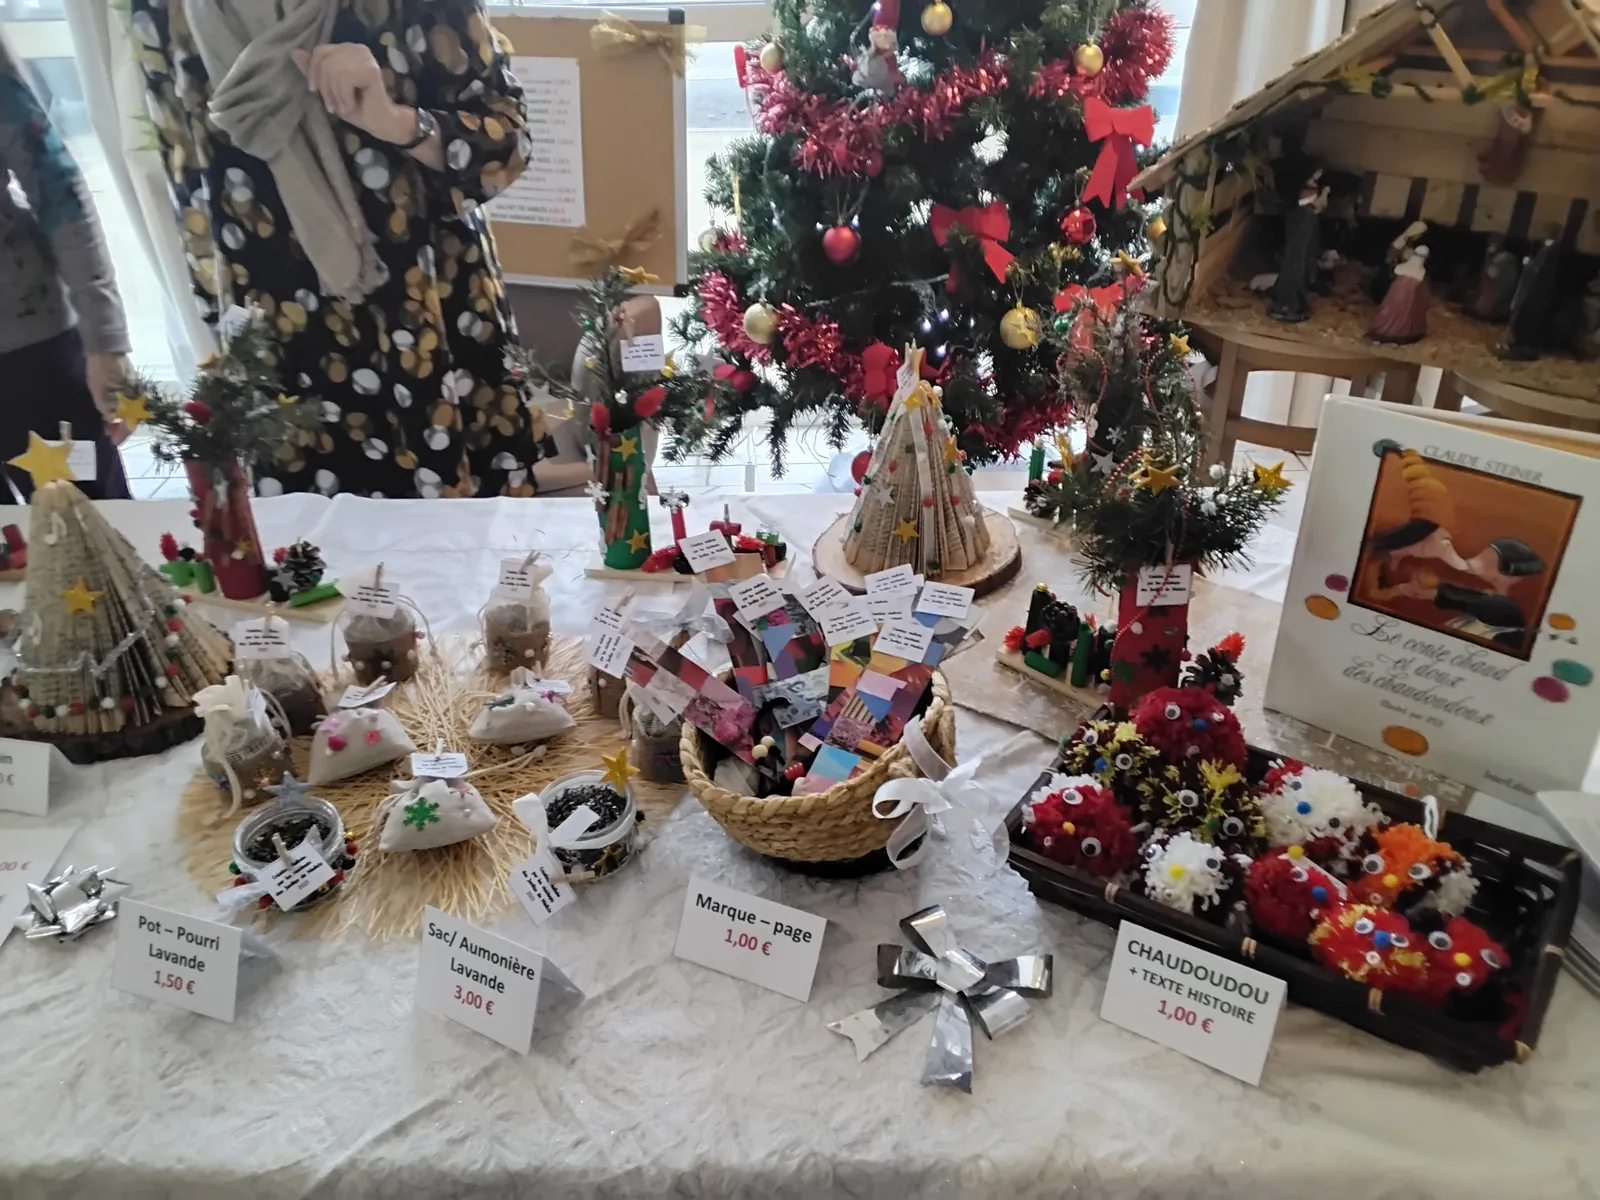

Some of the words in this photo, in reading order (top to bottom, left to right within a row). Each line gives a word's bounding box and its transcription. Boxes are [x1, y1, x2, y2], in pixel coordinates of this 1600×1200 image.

[1424, 445, 1481, 467] CLAUDE
[1484, 460, 1543, 484] STEINER
[138, 915, 161, 934] Pot
[176, 926, 220, 951] Pourri
[696, 893, 756, 925] Marque
[773, 921, 812, 943] page
[149, 943, 206, 972] Lavande
[428, 922, 457, 947] Sac/
[459, 936, 535, 980] Aumonière
[724, 928, 758, 951] 1,00
[762, 941, 772, 956] €
[154, 970, 183, 991] 1,50
[186, 980, 196, 995] €
[450, 957, 505, 994] Lavande
[1127, 940, 1270, 1005] CHAUDOUDOU
[454, 985, 482, 1009] 3,00
[485, 1000, 495, 1015] €
[1142, 968, 1184, 996] TEXTE
[1187, 987, 1256, 1025] HISTOIRE
[1157, 999, 1197, 1027] 1,00
[1201, 1018, 1214, 1034] €
